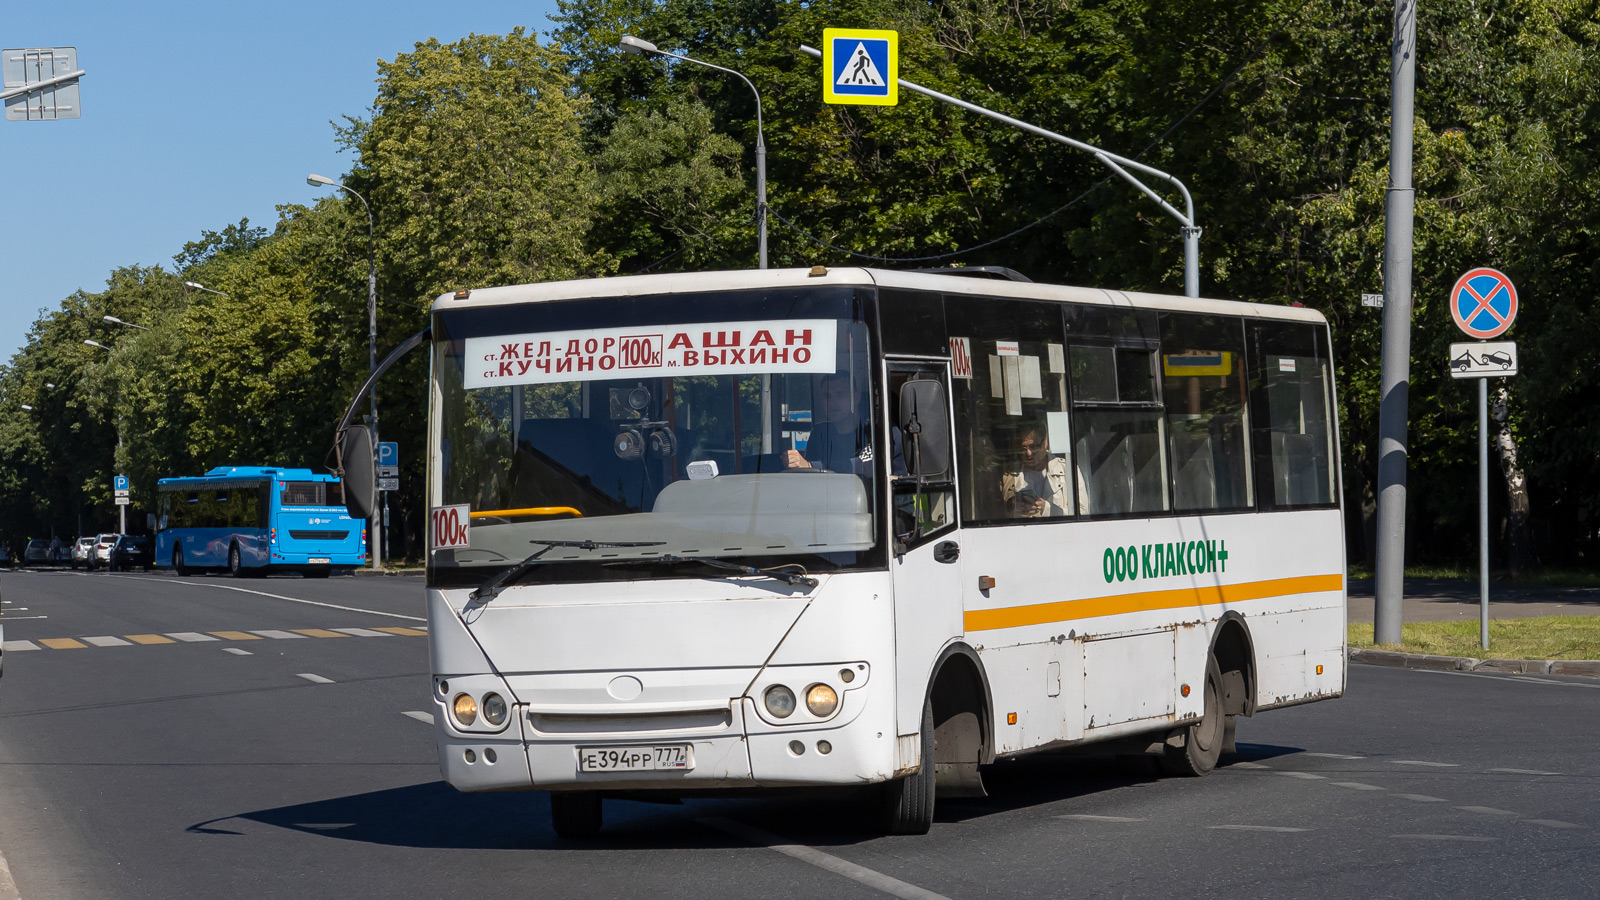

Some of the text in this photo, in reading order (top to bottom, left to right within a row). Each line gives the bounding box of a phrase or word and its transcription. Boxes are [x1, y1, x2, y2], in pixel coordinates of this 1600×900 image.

[500, 337, 616, 360] ЖЕЛ-ДОР
[667, 329, 812, 350] АШАН
[498, 355, 616, 377] КУЧИНО
[683, 347, 812, 367] ВЫХИНО
[1103, 539, 1228, 583] ООО КЛАКСОН+
[655, 748, 681, 762] 777
